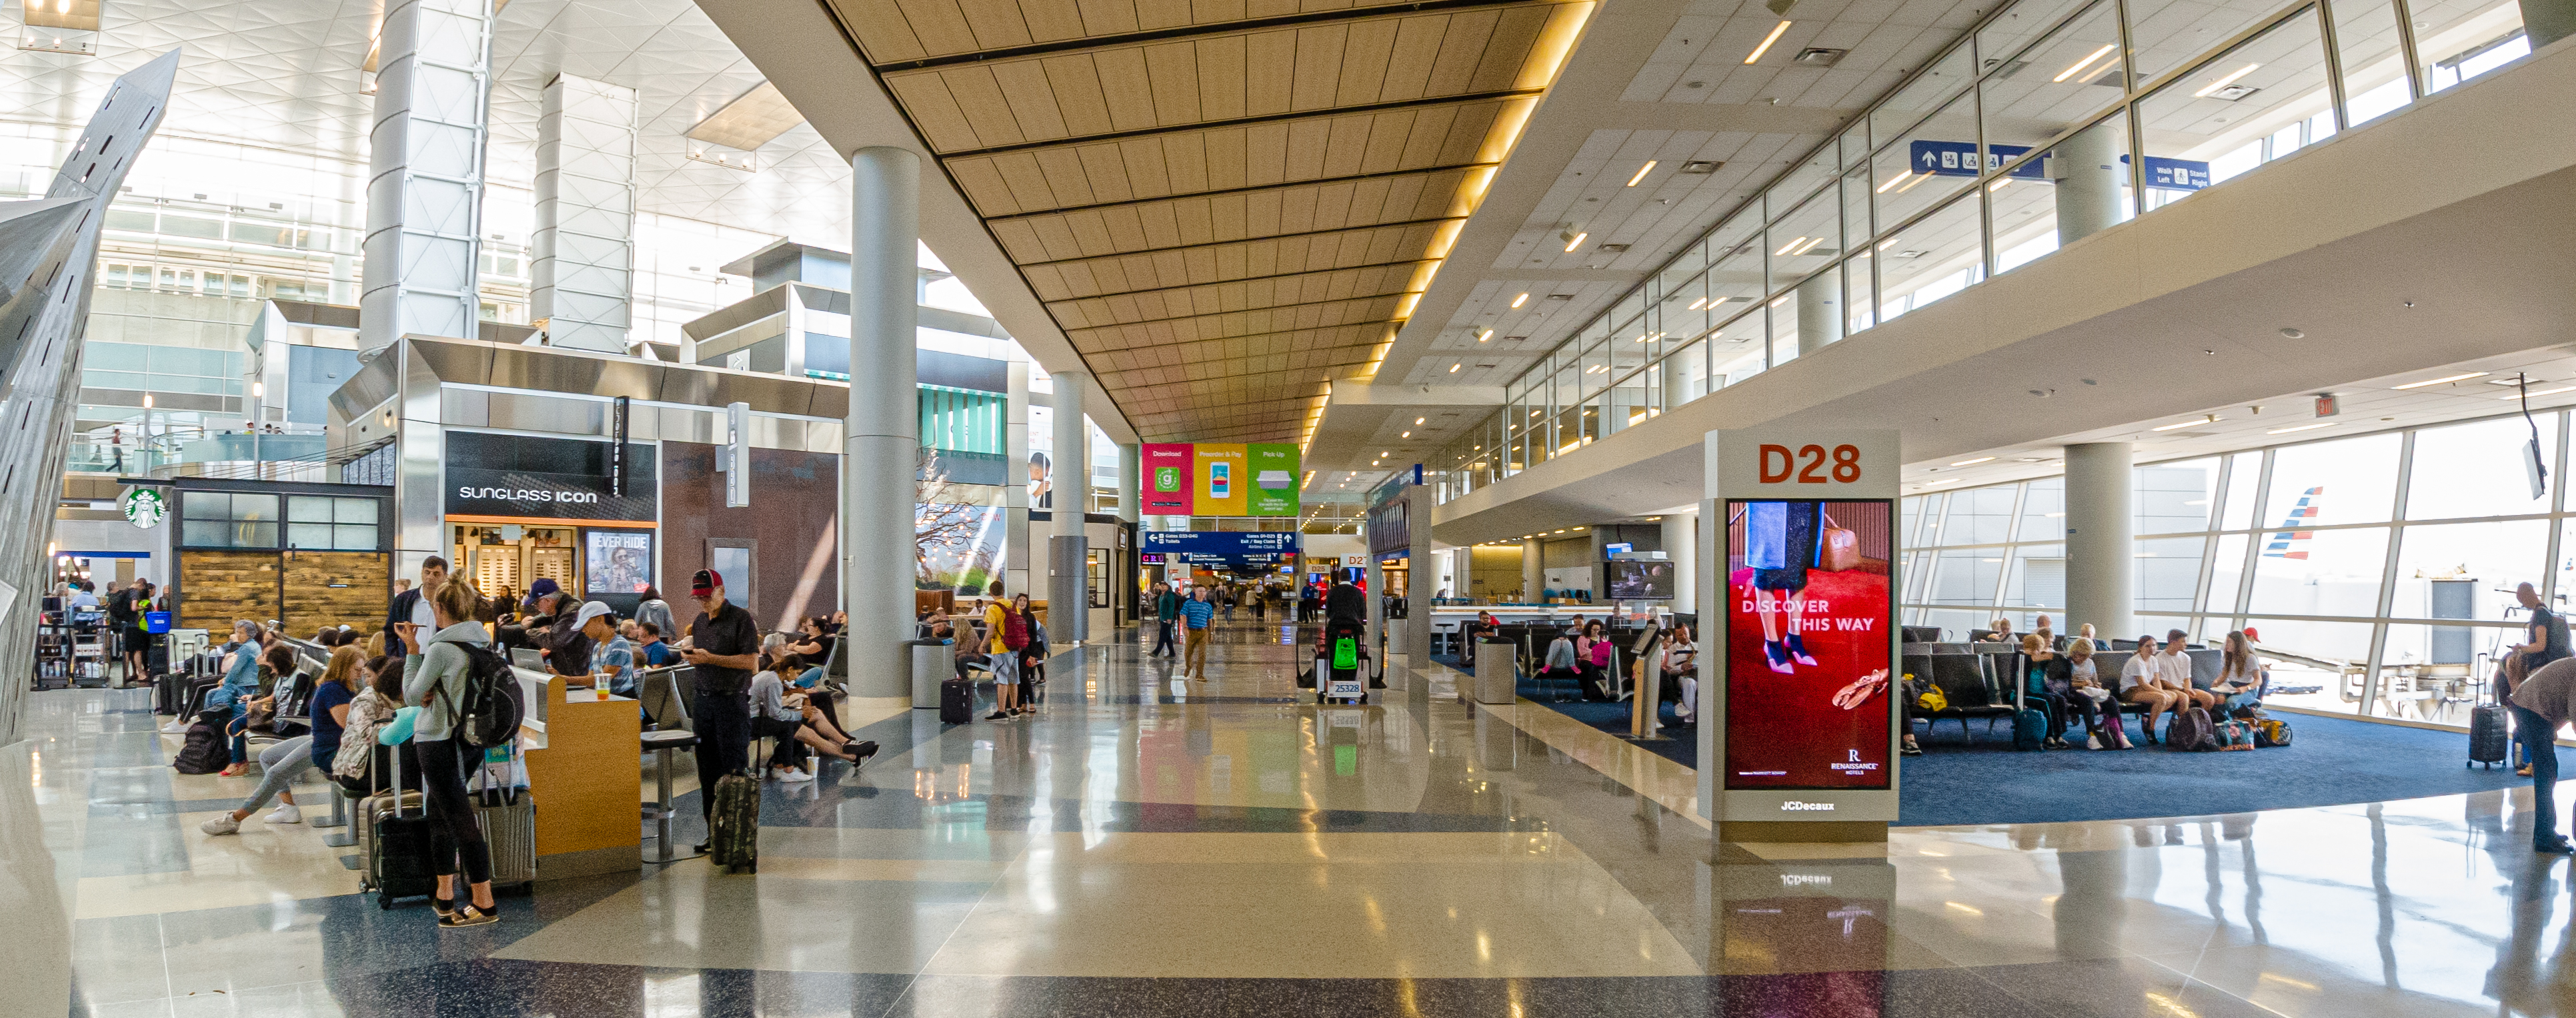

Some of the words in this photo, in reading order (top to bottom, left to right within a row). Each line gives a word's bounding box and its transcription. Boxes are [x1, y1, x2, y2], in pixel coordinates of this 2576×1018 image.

[2189, 169, 2207, 177] Stand
[2192, 179, 2208, 188] Right
[2319, 398, 2333, 415] EXIT
[1759, 444, 1861, 484] D28
[459, 486, 552, 501] SUNGLASS
[555, 491, 597, 503] ICON
[623, 536, 647, 549] HIDE
[1742, 600, 1828, 612] DISCOVER
[1792, 618, 1830, 631] THIS
[1836, 618, 1874, 631] WAY
[1335, 684, 1360, 692] 25328
[1848, 748, 1861, 762] R
[1781, 801, 1834, 811] JCDecaux
